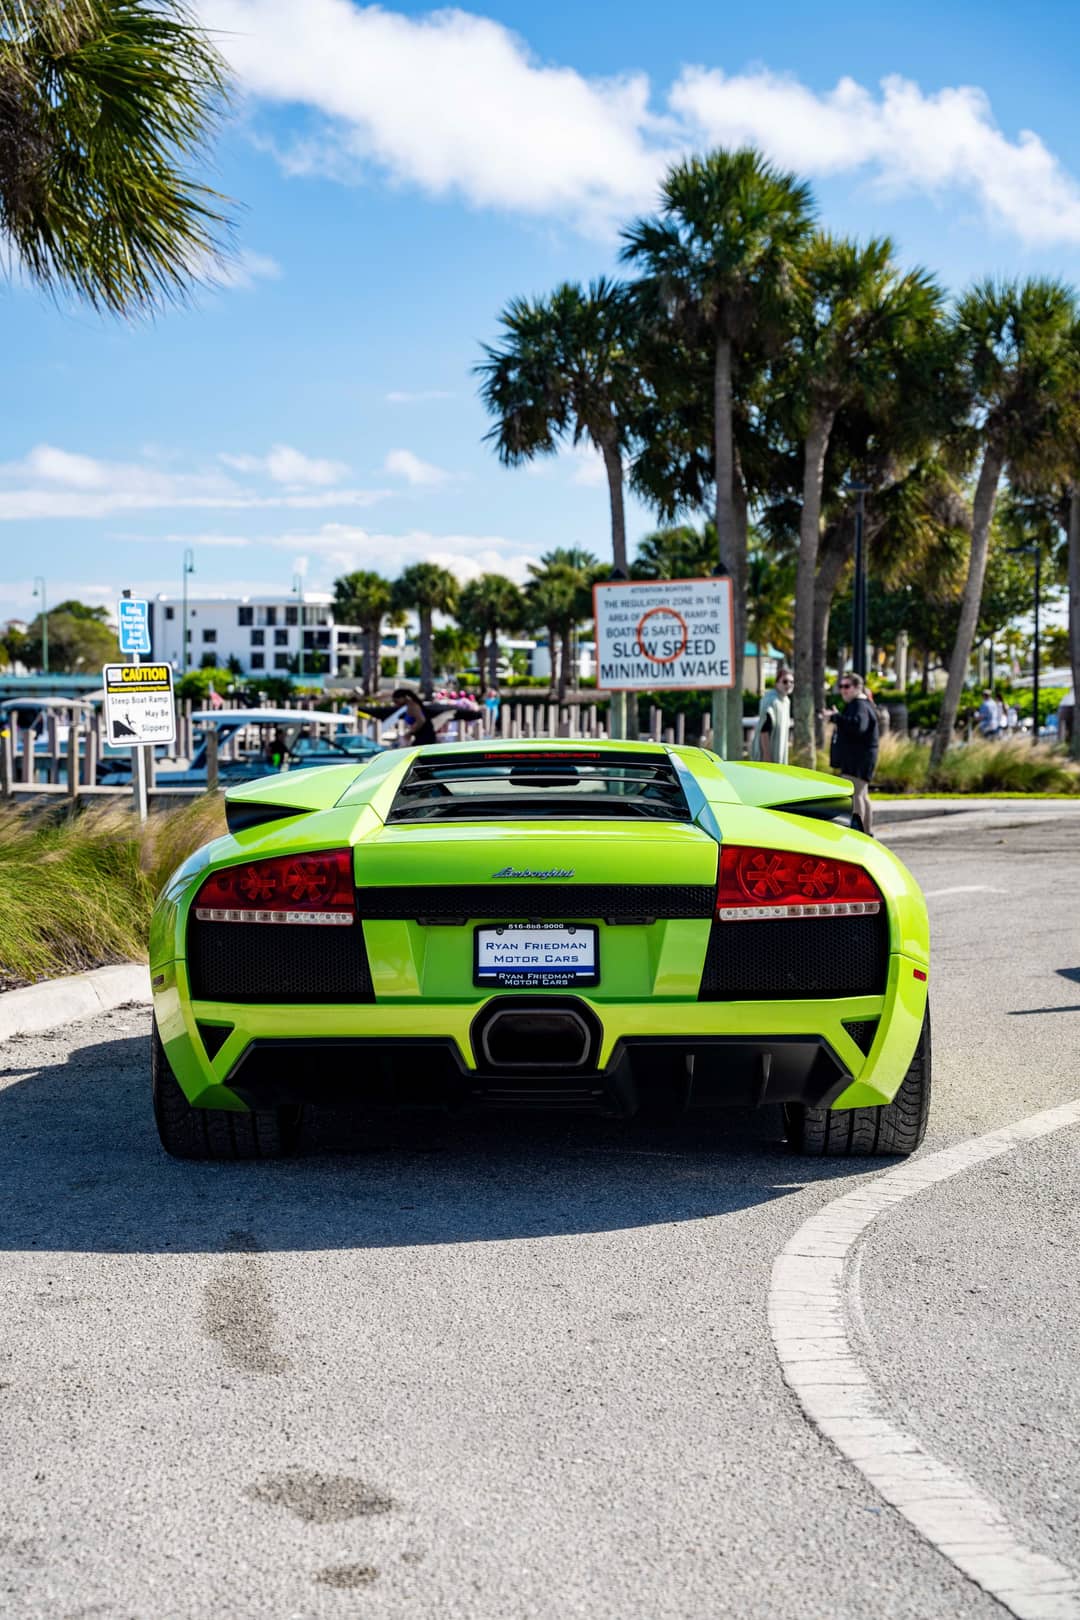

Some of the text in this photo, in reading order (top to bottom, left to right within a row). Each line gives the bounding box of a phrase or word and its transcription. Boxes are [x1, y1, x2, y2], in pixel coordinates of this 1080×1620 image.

[604, 600, 618, 608] THE
[621, 598, 670, 608] REGULATORY
[672, 597, 693, 605] ZONE
[706, 595, 721, 604] THE
[608, 613, 628, 622] AREA
[631, 613, 641, 621] OF
[684, 610, 708, 618] RAMP
[710, 610, 718, 618] IS
[606, 624, 721, 638] BOATING SAFETY ZONE
[612, 639, 716, 658] SLOW SPEED
[122, 667, 167, 682] CAUTION
[600, 660, 729, 680] MINIMUM WAKE
[111, 695, 168, 705] Steep Boat Ramp
[145, 709, 168, 718] May Be
[142, 724, 170, 732] Slippery
[492, 866, 576, 880] Lamborghini
[486, 942, 587, 950] RYAN FRIEDMAN
[494, 955, 579, 963] MOTOR CARS
